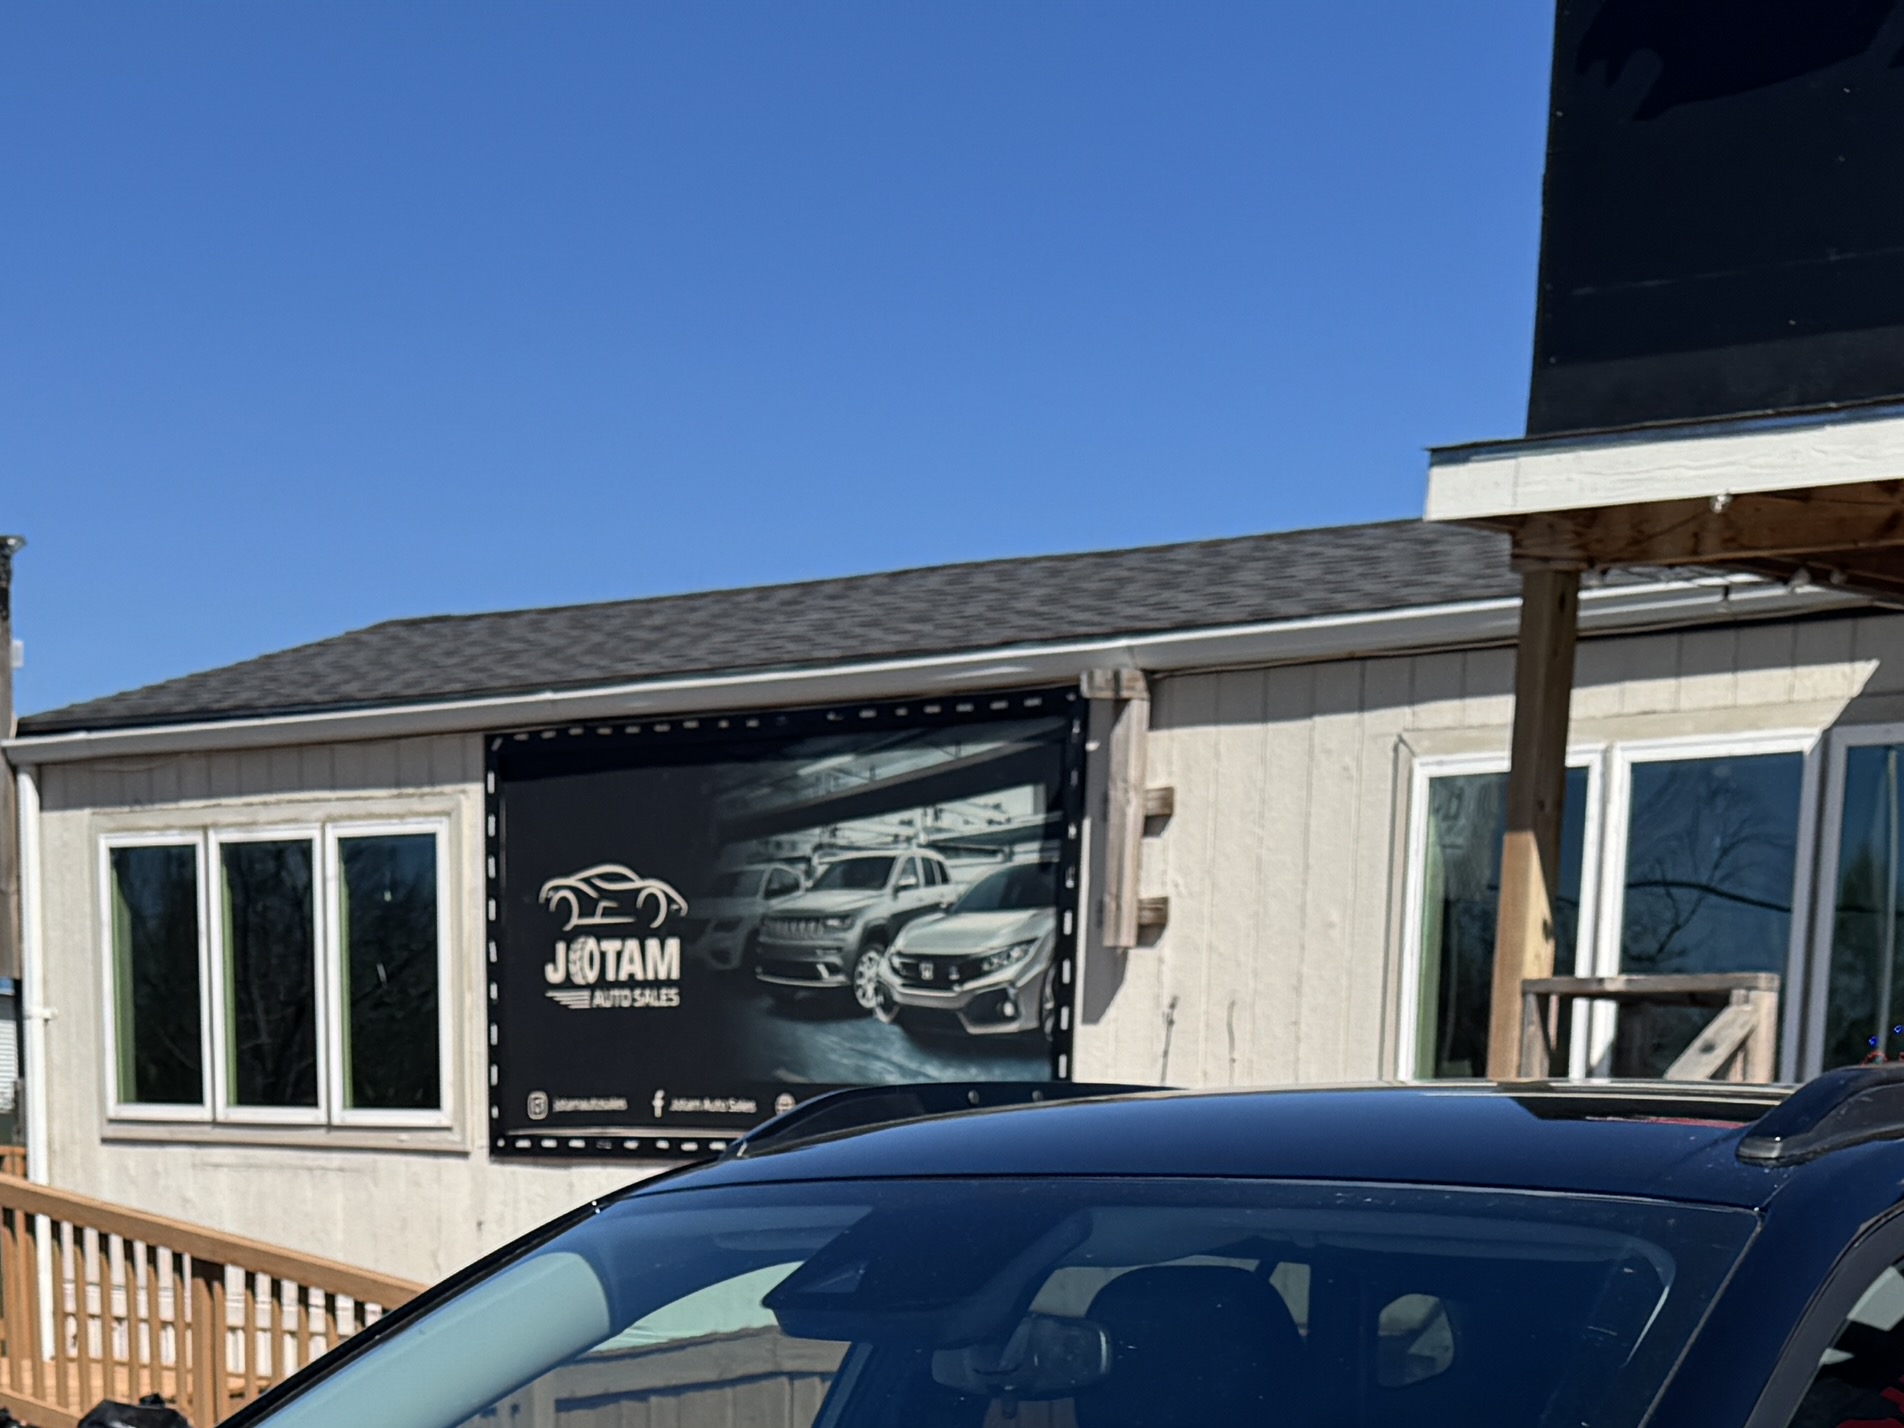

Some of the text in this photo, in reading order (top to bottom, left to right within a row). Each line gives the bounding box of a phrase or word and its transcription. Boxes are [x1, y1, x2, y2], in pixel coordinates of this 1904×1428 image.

[545, 935, 680, 985] JOTAM
[593, 987, 680, 1008] AUTO SALES
